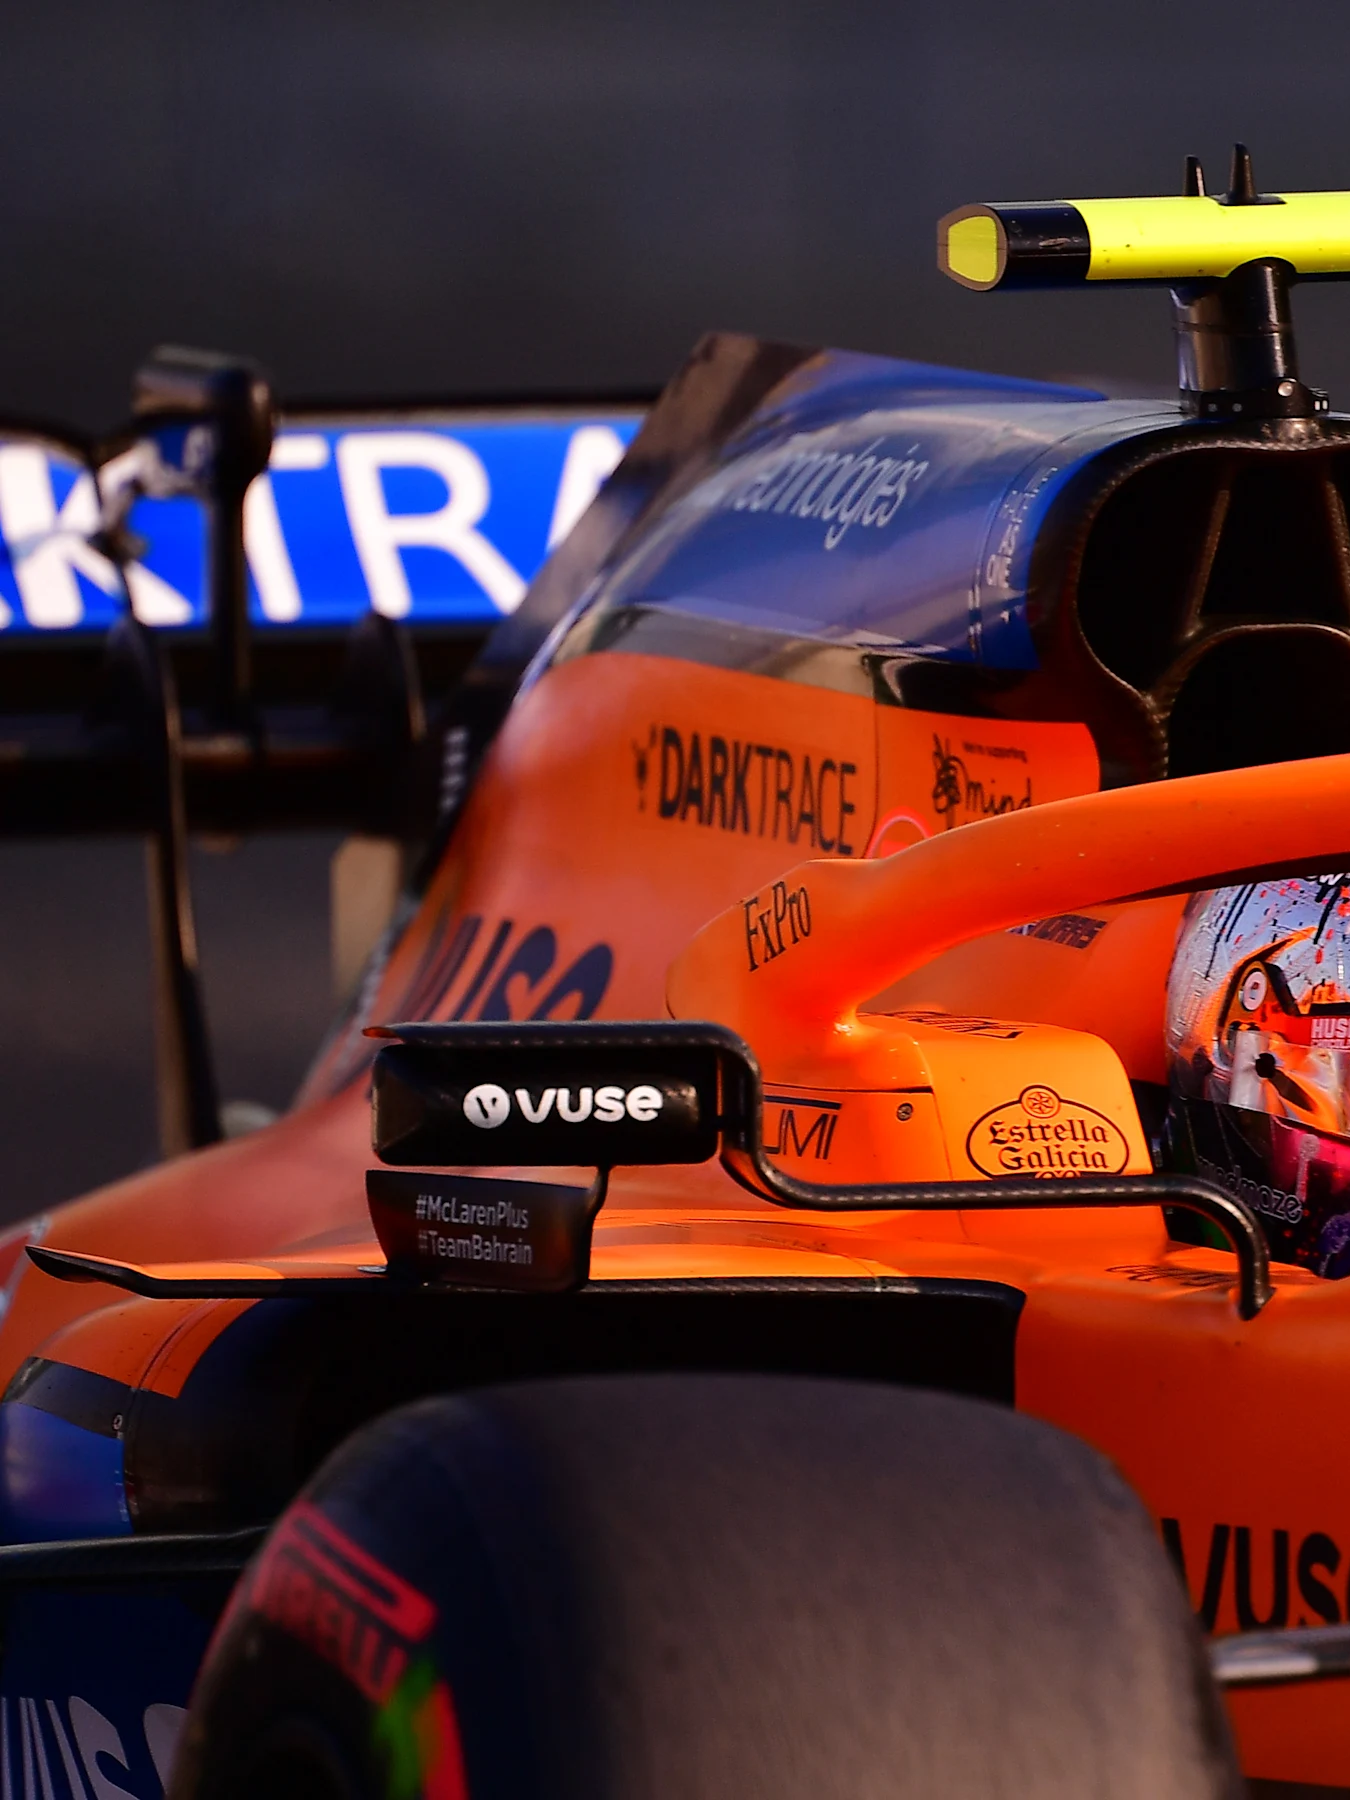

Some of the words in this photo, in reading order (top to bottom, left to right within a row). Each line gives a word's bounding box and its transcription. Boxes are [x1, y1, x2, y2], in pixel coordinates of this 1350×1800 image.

[659, 727, 857, 856] DARKTRACE
[743, 880, 812, 973] FxPro
[764, 1096, 842, 1160] UMI
[989, 1120, 1109, 1145] Estrella
[998, 1144, 1109, 1171] Galicia
[415, 1193, 529, 1229] #McLarenPlus
[417, 1228, 533, 1264] #TeamBahrain
